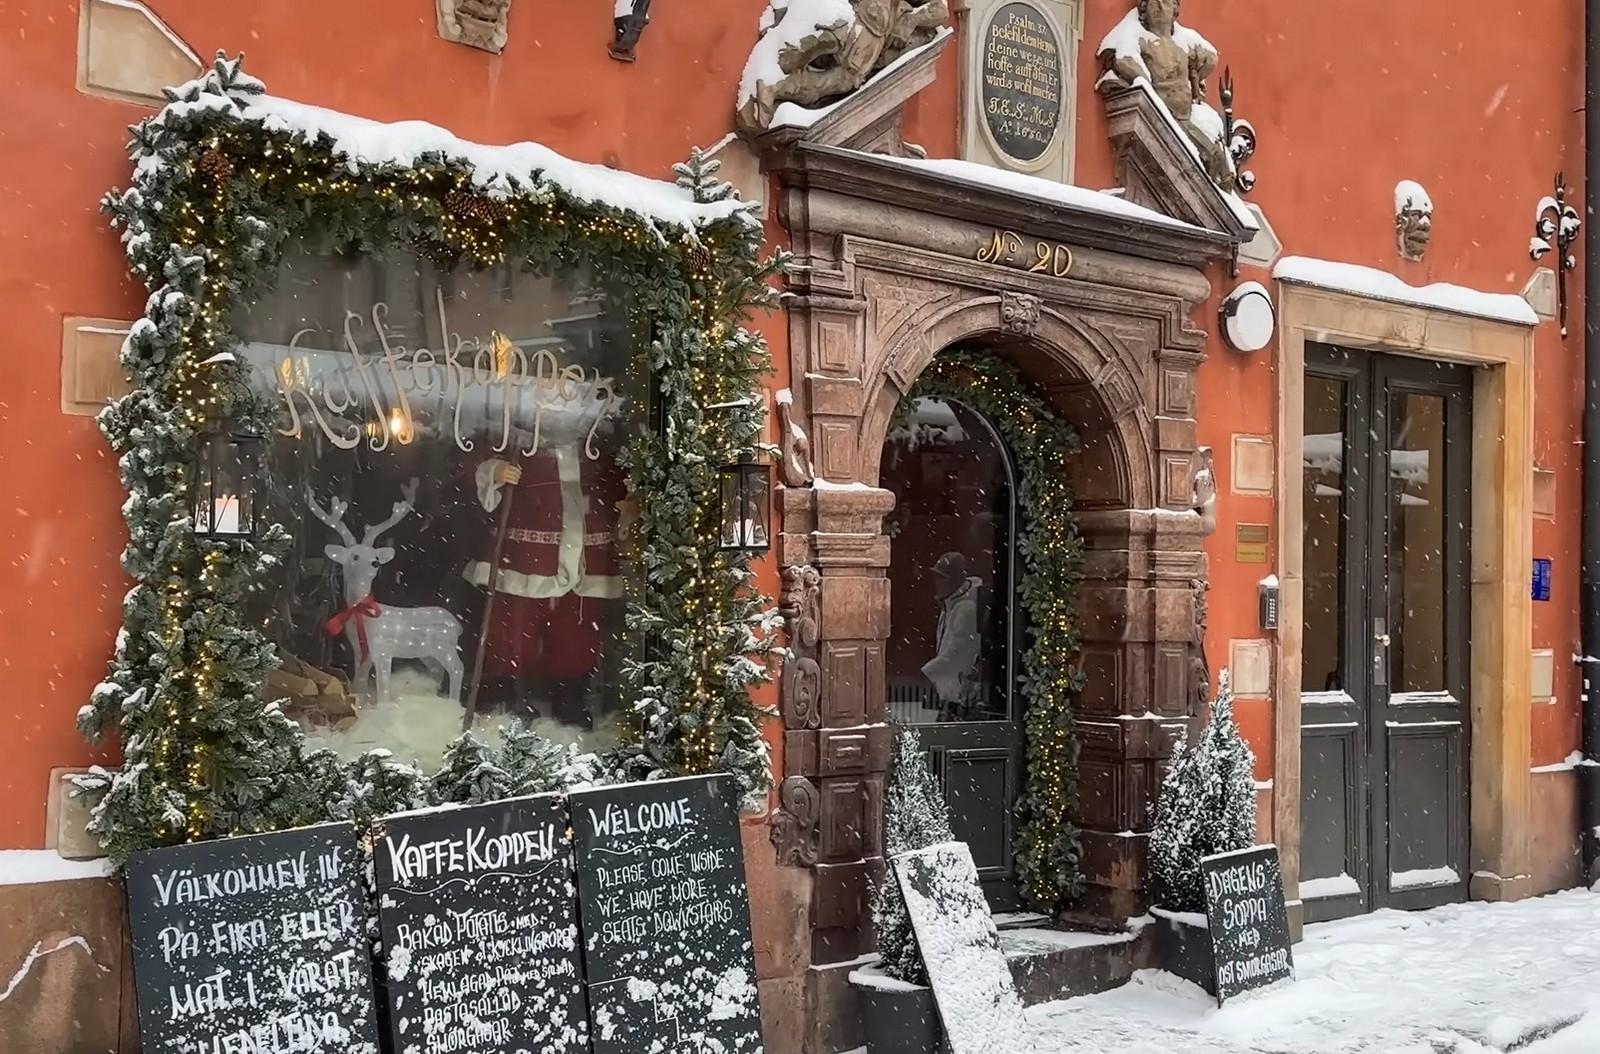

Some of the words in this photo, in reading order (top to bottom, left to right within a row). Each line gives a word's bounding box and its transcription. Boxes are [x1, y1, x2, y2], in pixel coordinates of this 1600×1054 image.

[987, 52, 1013, 73] hoffe
[988, 38, 1018, 58] deine
[1028, 241, 1073, 277] 20
[588, 798, 695, 838] WELCOME
[152, 851, 307, 906] VÄLKOMMEN
[318, 846, 342, 882] IN
[597, 864, 646, 889] PLEASE
[651, 855, 685, 878] COME
[689, 849, 726, 873] INSIDE
[1209, 861, 1267, 903] DAGENS
[597, 896, 621, 917] WE
[629, 887, 664, 912] HAVE
[671, 878, 708, 902] MORE
[1223, 897, 1267, 930] SOPPA
[158, 921, 200, 966] PÅ
[212, 919, 267, 954] FIKA
[281, 900, 357, 941] ELLER
[397, 923, 453, 952] BAKAD
[455, 908, 508, 942] POTATIS
[602, 916, 646, 945] SEATS
[1238, 928, 1261, 949] MED
[1218, 960, 1235, 986] OST
[169, 969, 231, 1019] MAT
[247, 972, 258, 1008] I
